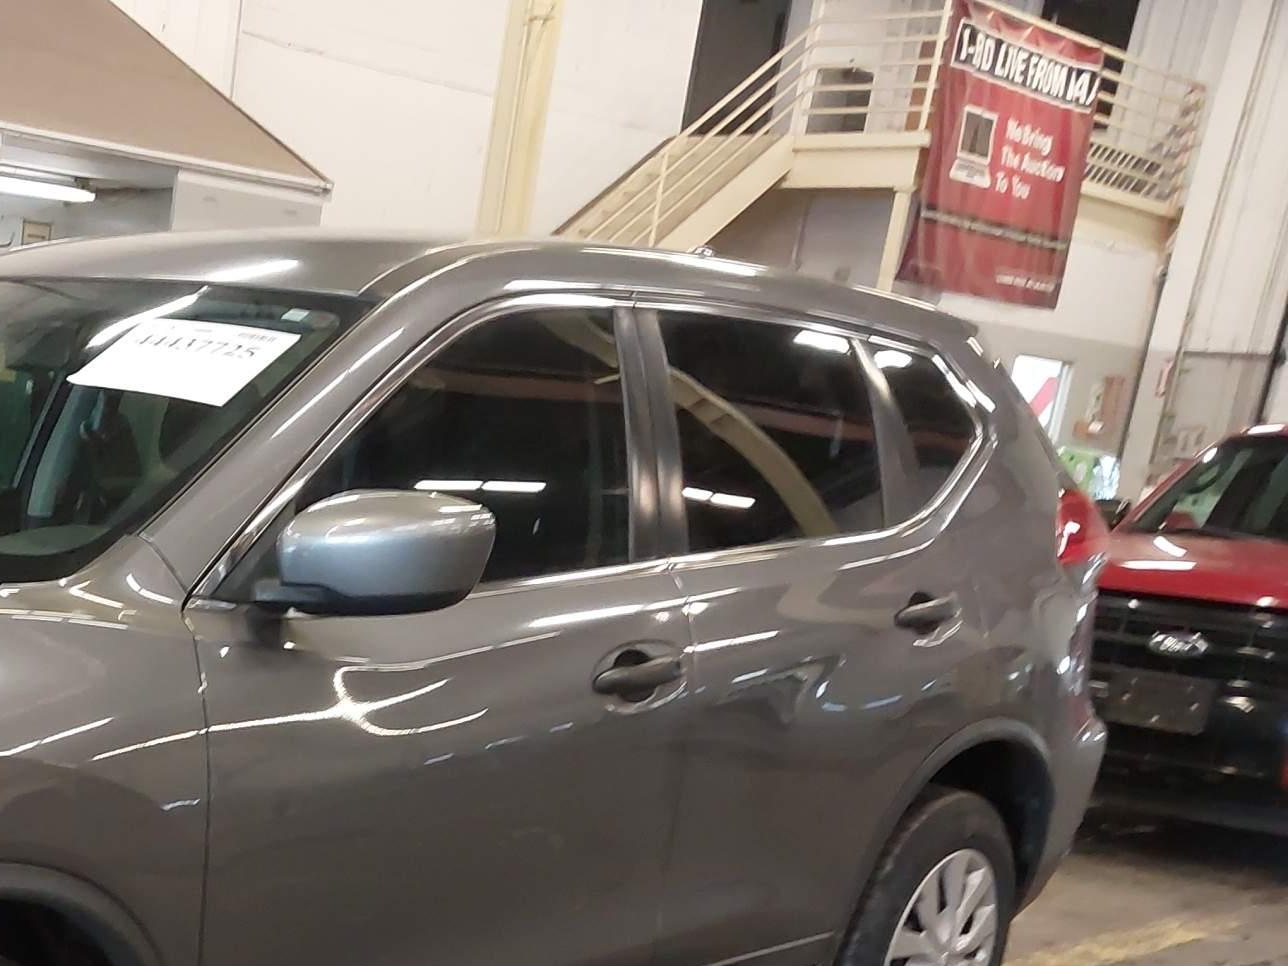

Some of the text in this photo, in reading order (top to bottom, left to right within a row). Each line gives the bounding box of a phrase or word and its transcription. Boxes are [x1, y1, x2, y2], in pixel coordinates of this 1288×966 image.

[994, 42, 1030, 84] LIVE
[1026, 55, 1069, 98] FROM
[995, 172, 1032, 199] To You
